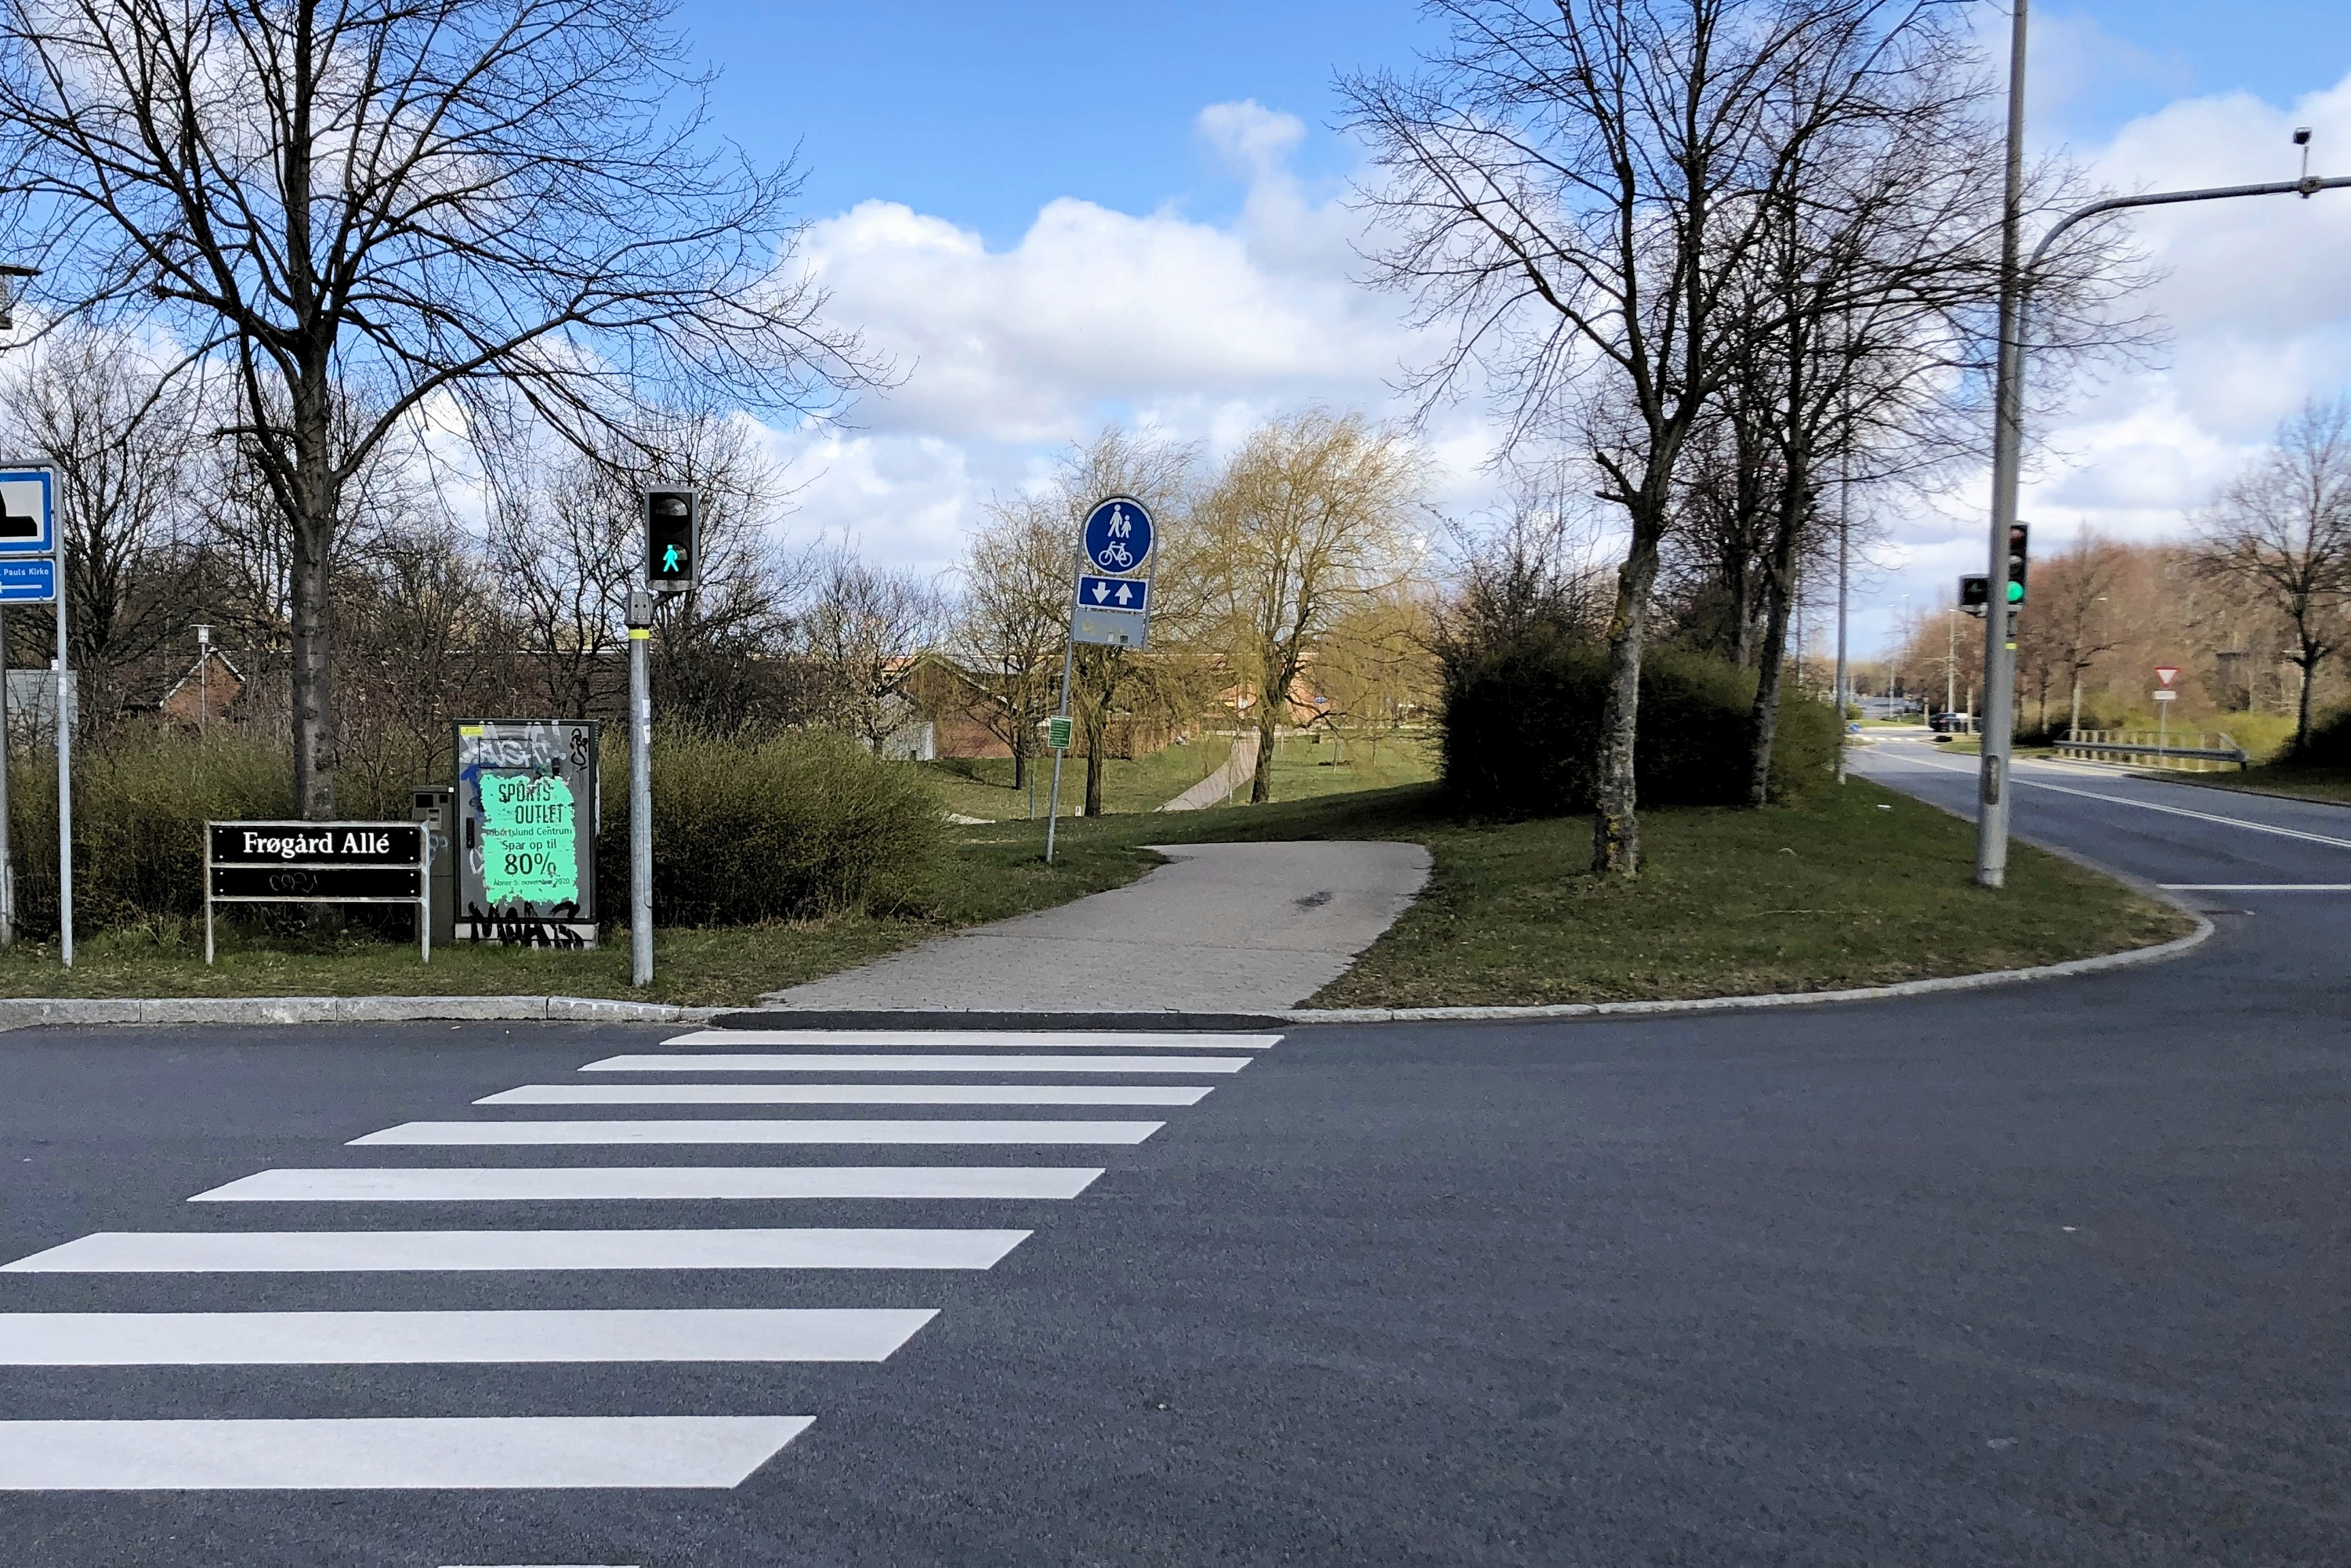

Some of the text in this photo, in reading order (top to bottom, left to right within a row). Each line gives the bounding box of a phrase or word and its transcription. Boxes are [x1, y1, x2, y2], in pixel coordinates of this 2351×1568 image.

[515, 804, 563, 824] OUTLET
[243, 831, 390, 859] Frøgård Allé
[502, 838, 557, 852] Spar op til
[504, 851, 556, 875] 80%
